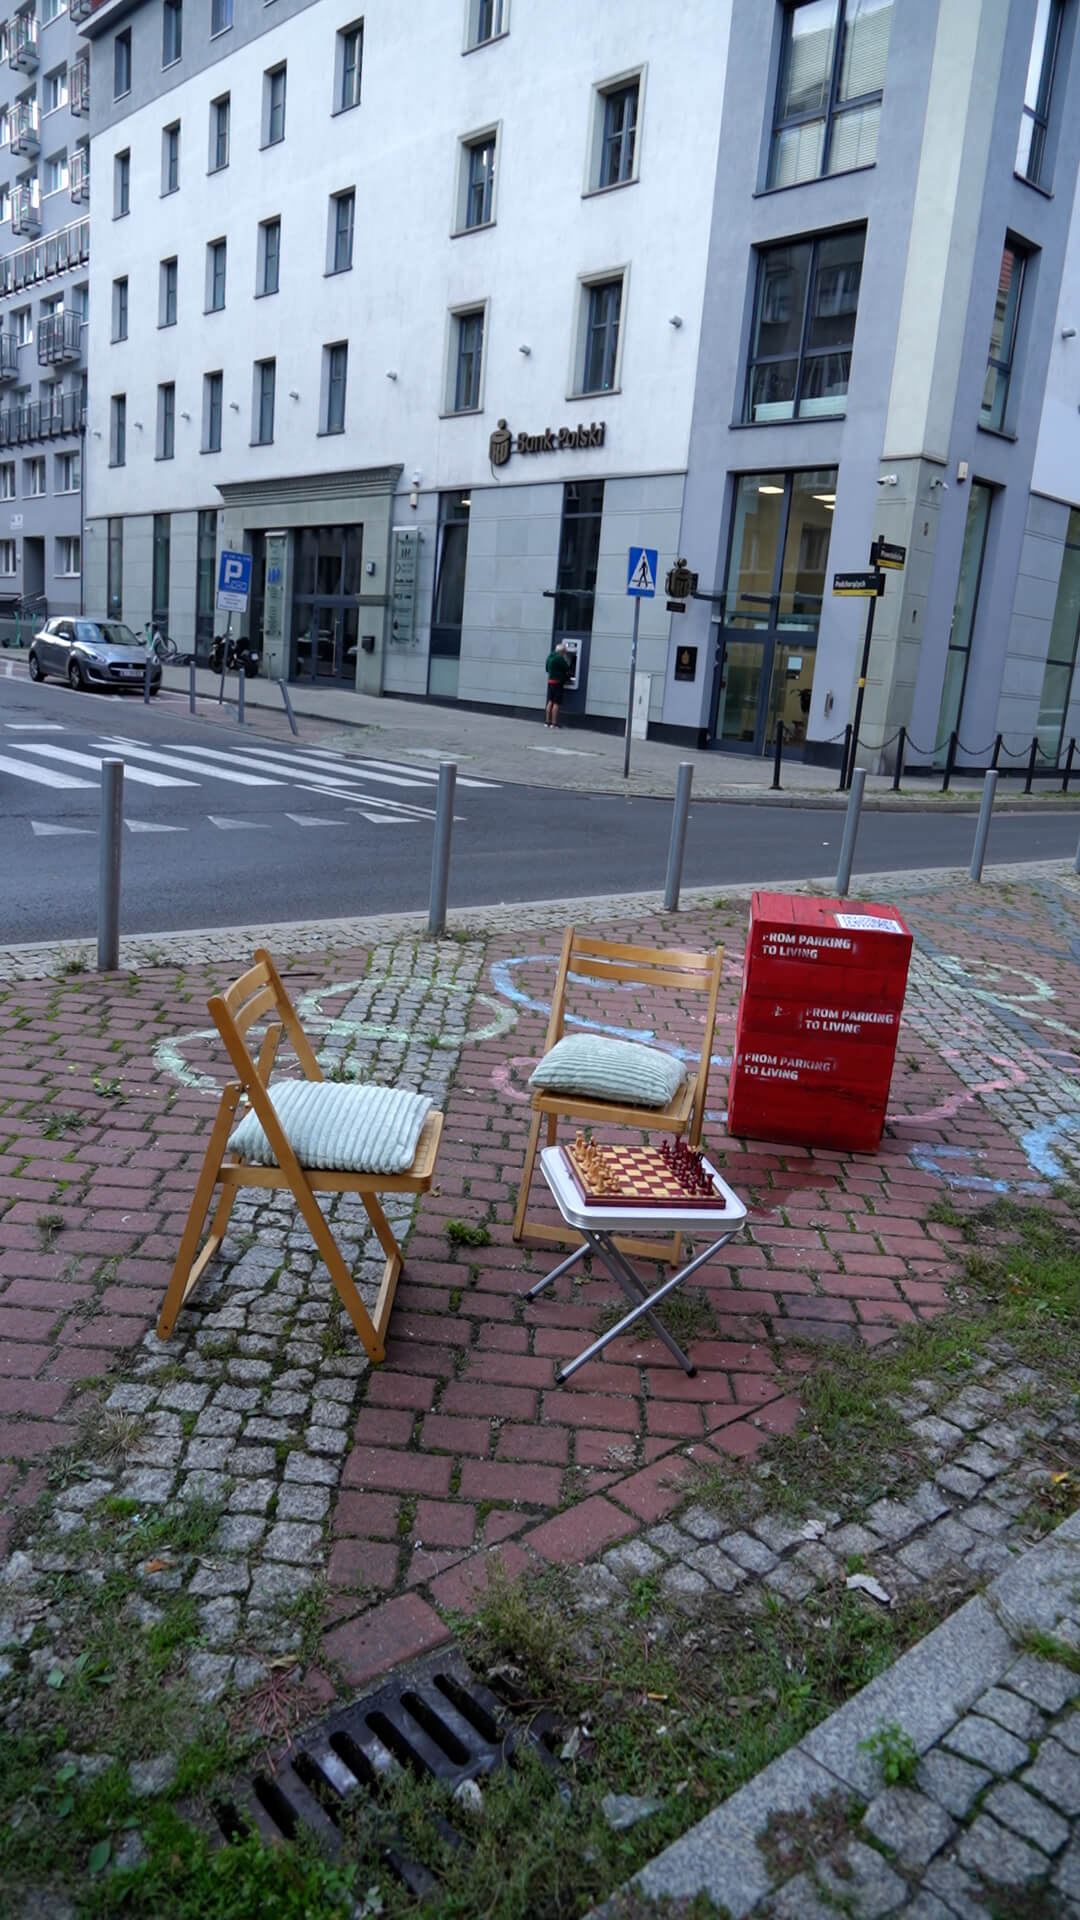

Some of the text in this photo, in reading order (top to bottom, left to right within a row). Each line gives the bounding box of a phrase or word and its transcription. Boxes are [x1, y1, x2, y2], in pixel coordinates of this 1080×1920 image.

[517, 427, 553, 454] Bank
[557, 421, 606, 449] Polski
[224, 560, 243, 584] P
[798, 935, 851, 950] PARKING
[762, 945, 818, 959] TO LIVING
[841, 1010, 894, 1024] PARKING
[805, 1020, 861, 1034] TO LIVING
[745, 1053, 831, 1072] FROM PARKING
[744, 1064, 798, 1080] TO LIVING
